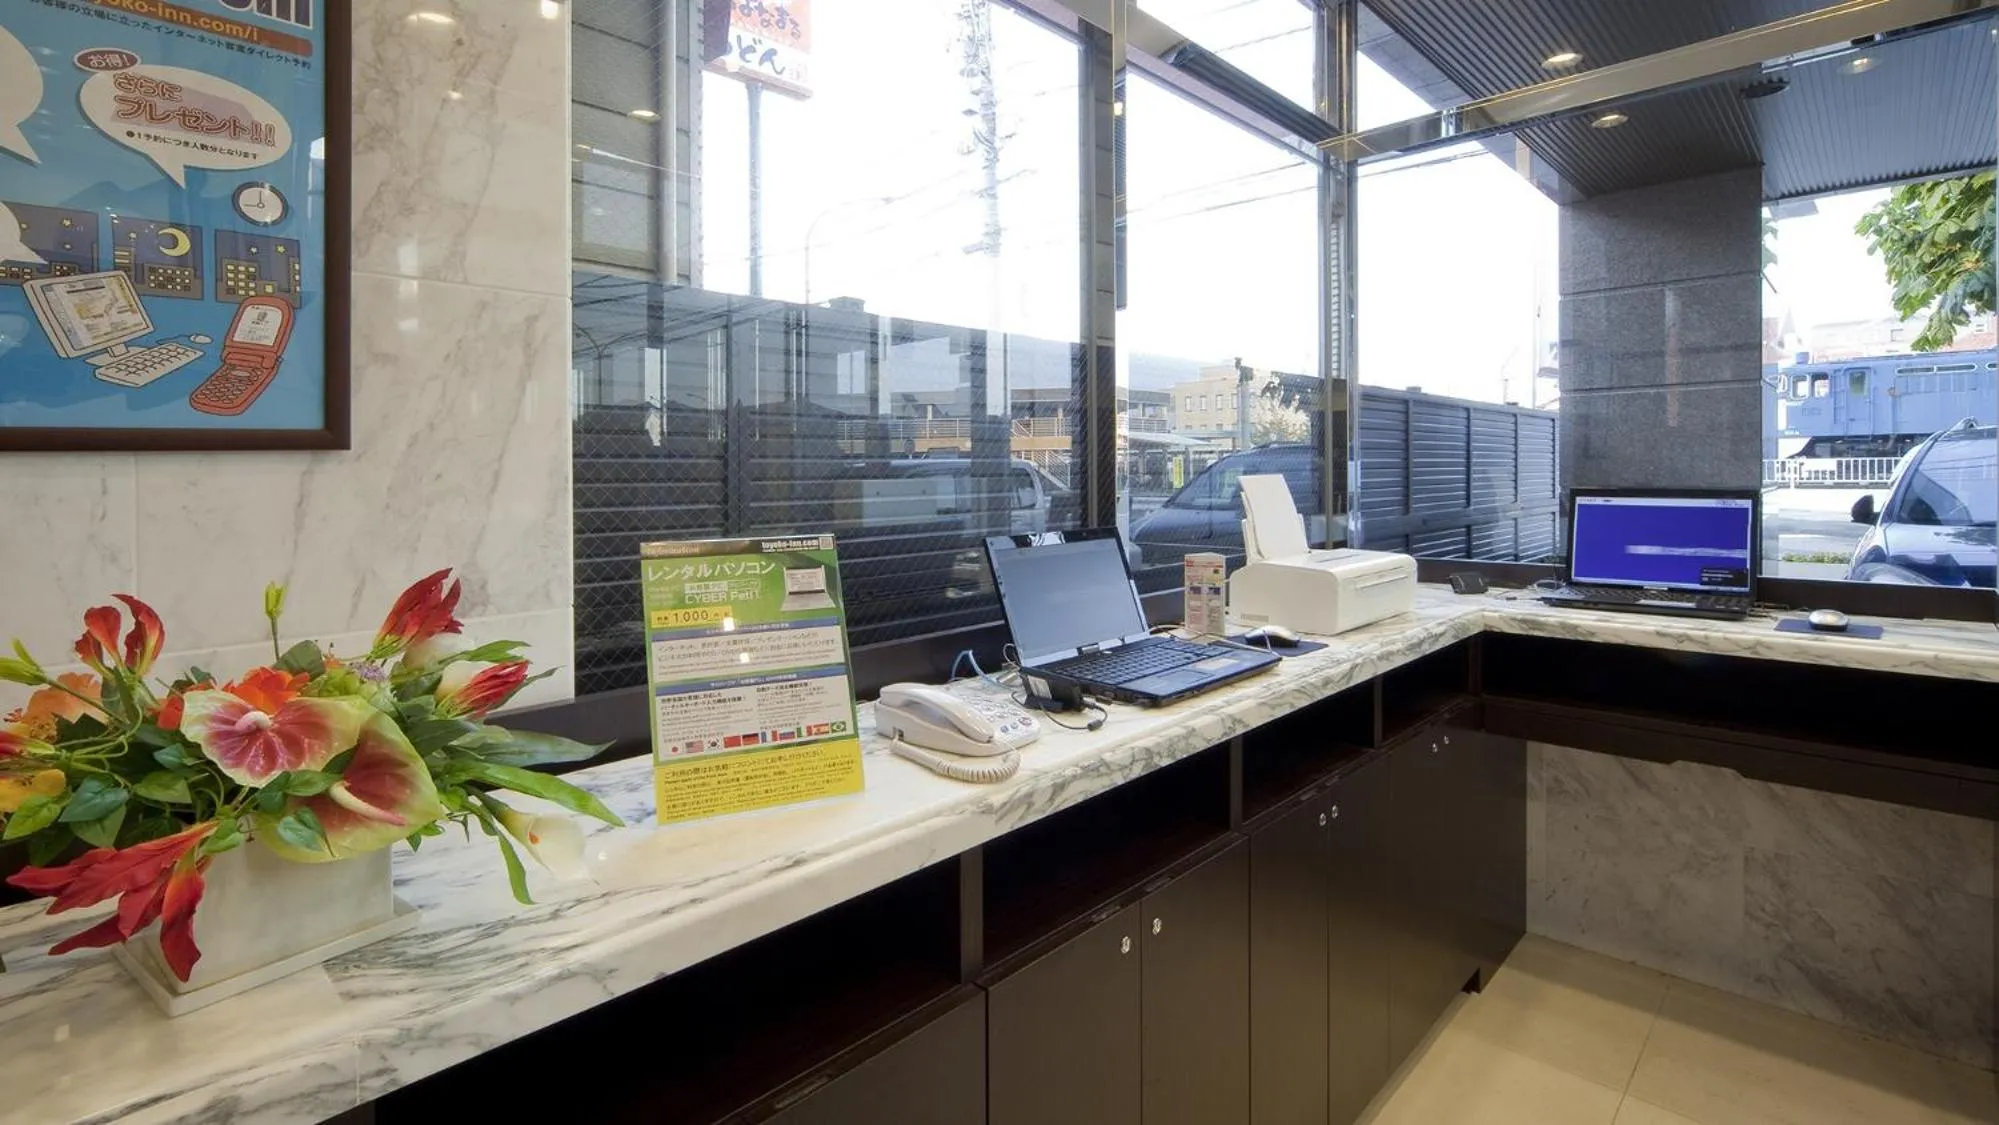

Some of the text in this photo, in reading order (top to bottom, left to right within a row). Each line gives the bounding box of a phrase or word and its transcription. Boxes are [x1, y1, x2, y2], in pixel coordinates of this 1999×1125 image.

[727, 34, 786, 75] どん
[112, 71, 182, 101] さらに
[648, 561, 776, 582] レンタルパソコン
[684, 592, 728, 604] CYBER
